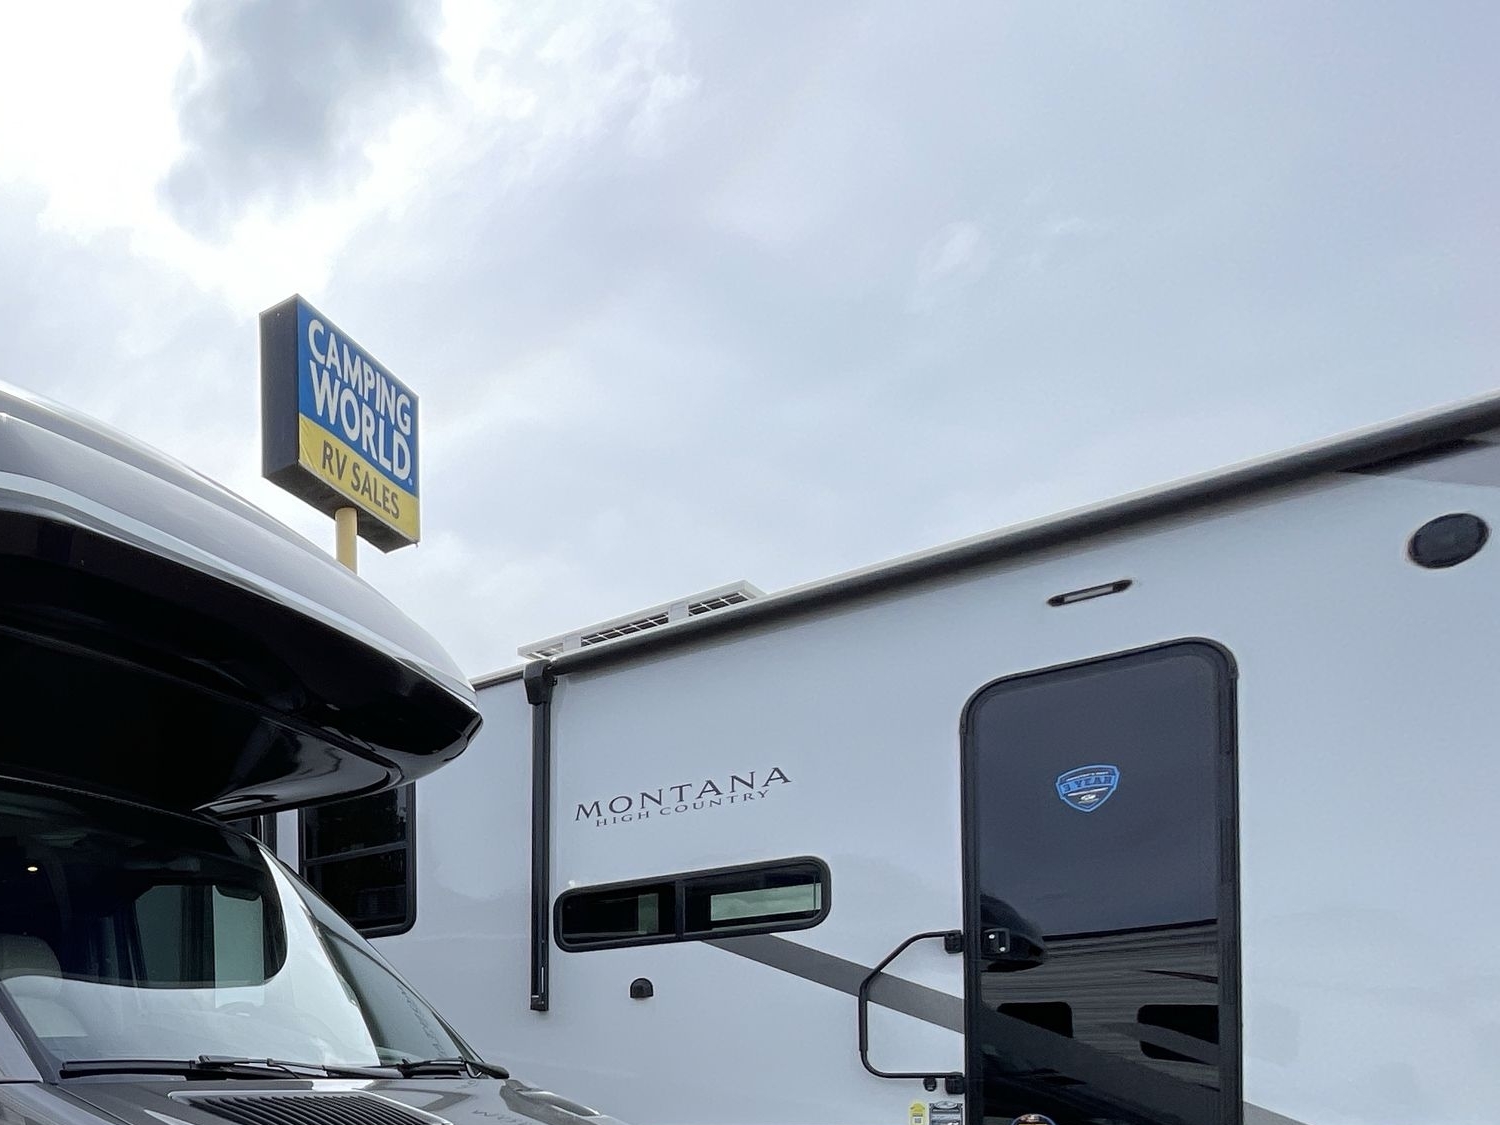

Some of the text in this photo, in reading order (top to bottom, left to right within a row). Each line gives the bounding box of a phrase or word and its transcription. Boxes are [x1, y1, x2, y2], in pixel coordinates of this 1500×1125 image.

[308, 319, 411, 436] CAMPING
[309, 359, 411, 481] WORLD
[321, 439, 400, 520] RV SALES
[575, 767, 792, 821] MONTANA
[595, 789, 770, 828] HIGH COUNTRY
